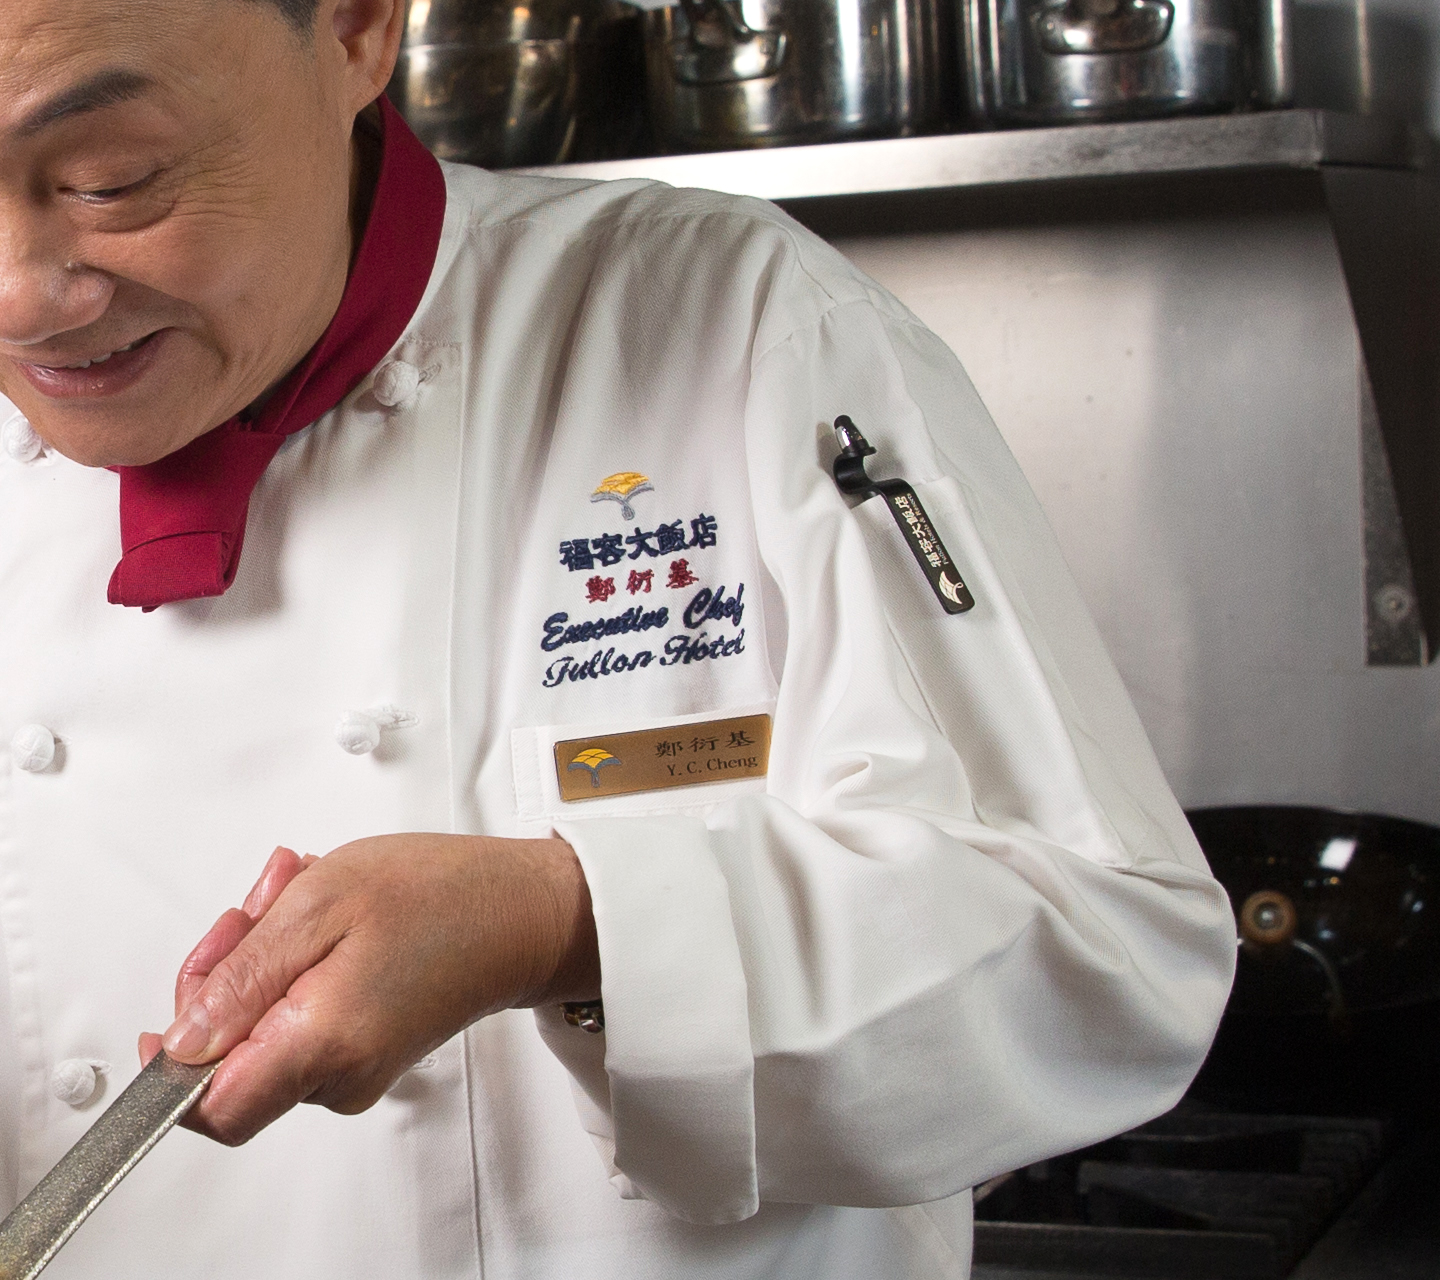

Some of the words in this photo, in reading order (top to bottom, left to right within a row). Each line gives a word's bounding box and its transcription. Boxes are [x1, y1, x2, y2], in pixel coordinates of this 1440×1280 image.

[559, 513, 718, 572] 福容大飯店
[541, 605, 669, 652] Executive
[682, 583, 745, 629] Chef
[542, 647, 657, 688] Fullon
[659, 628, 745, 666] Hotel
[706, 756, 759, 771] Cheng
